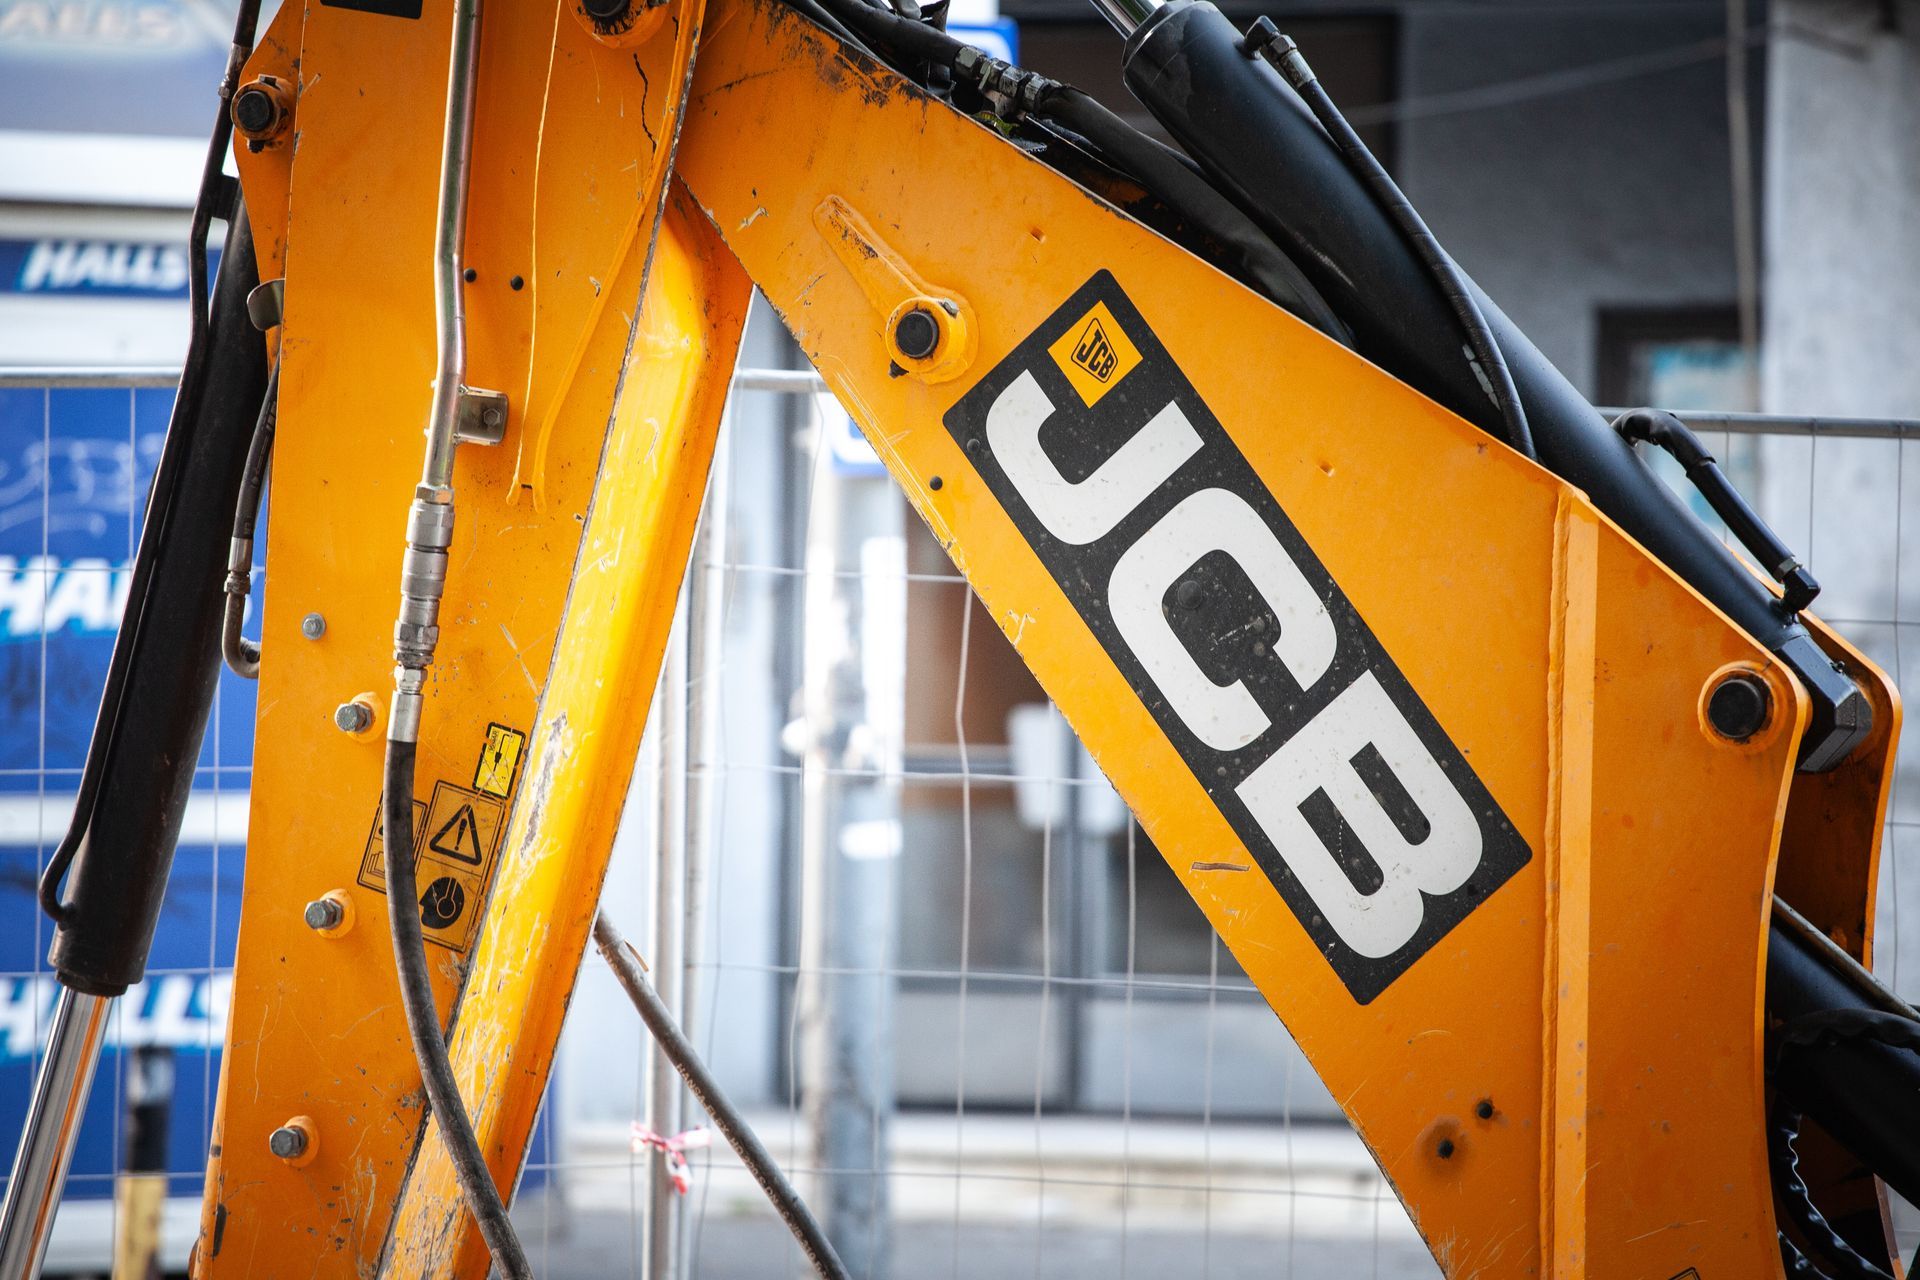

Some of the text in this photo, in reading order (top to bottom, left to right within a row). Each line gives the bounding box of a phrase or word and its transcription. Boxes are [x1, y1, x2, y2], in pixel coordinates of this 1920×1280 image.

[22, 240, 189, 291] HALLS
[1076, 328, 1115, 378] JCB
[985, 368, 1484, 959] JCB
